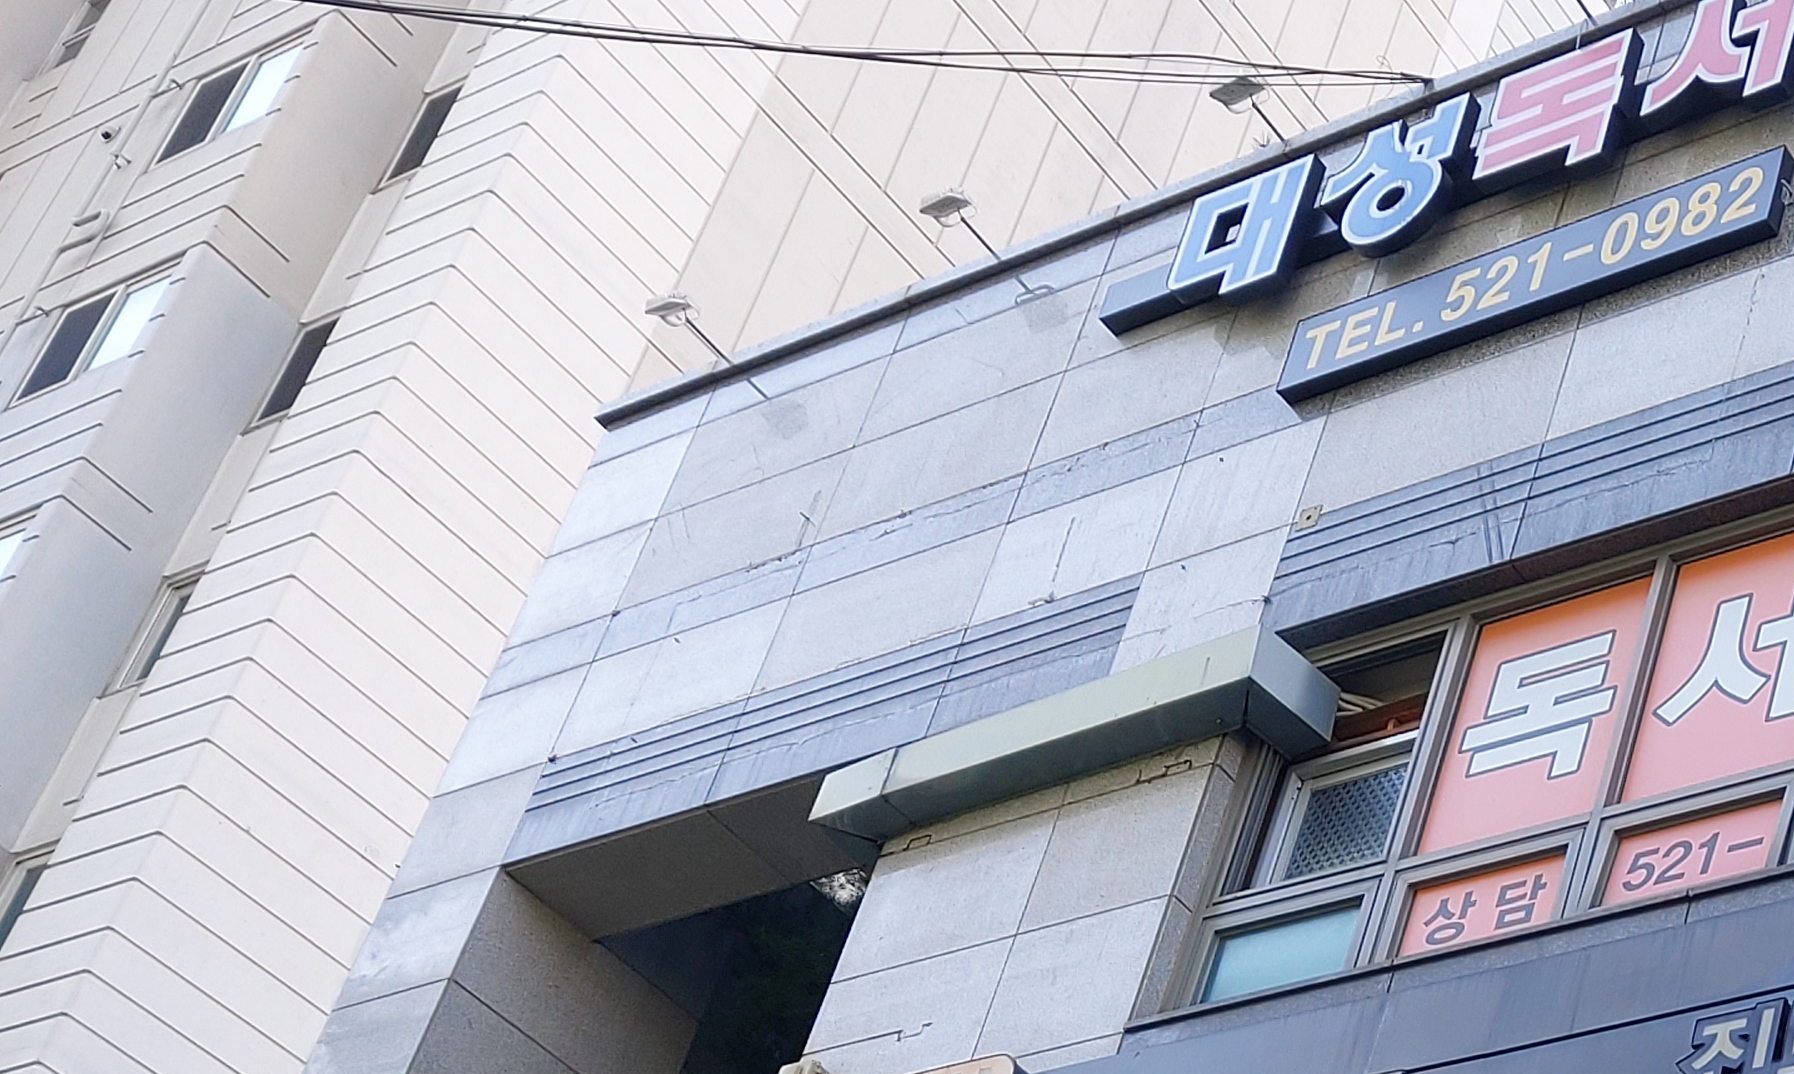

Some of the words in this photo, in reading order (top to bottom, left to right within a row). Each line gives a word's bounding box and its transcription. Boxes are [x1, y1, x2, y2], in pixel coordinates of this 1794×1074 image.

[1304, 300, 1425, 370] TEL.
[1440, 166, 1765, 323] 521-0982
[1423, 872, 1548, 946] 상담
